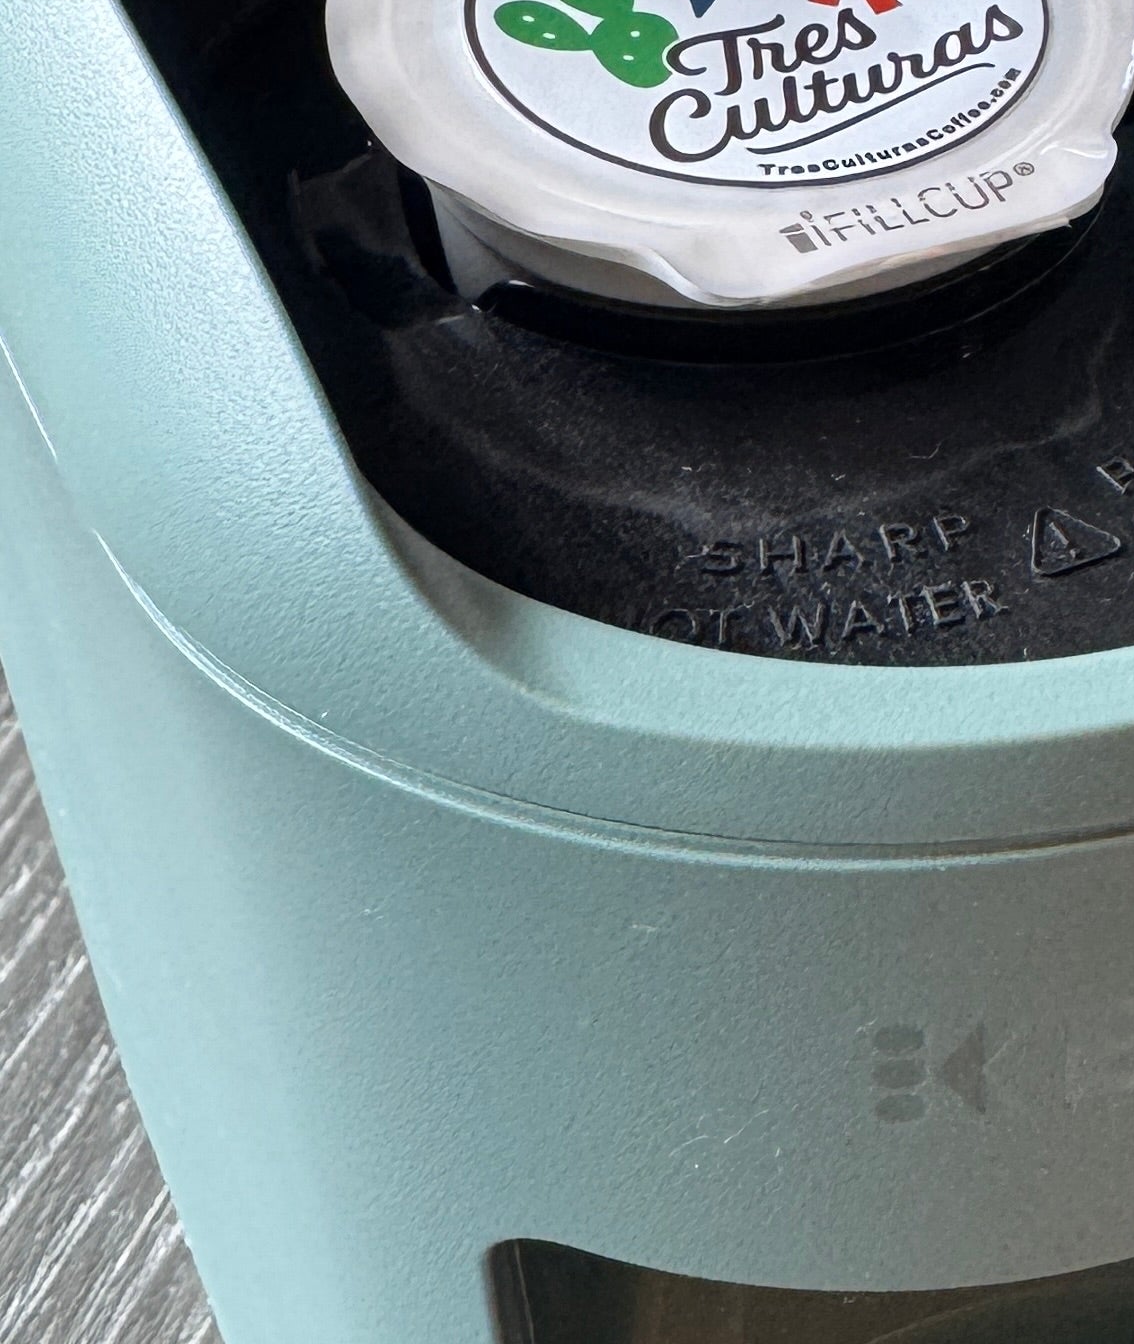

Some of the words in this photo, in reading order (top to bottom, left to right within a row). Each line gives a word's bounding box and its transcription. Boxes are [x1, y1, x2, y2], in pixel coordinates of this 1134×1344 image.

[649, 5, 1023, 163] Culturas
[666, 8, 876, 96] Tres
[758, 68, 1022, 175] TresCulturasCoffee.com
[701, 512, 971, 575] SHARP
[649, 606, 756, 645] OT
[768, 580, 1009, 650] WATER
